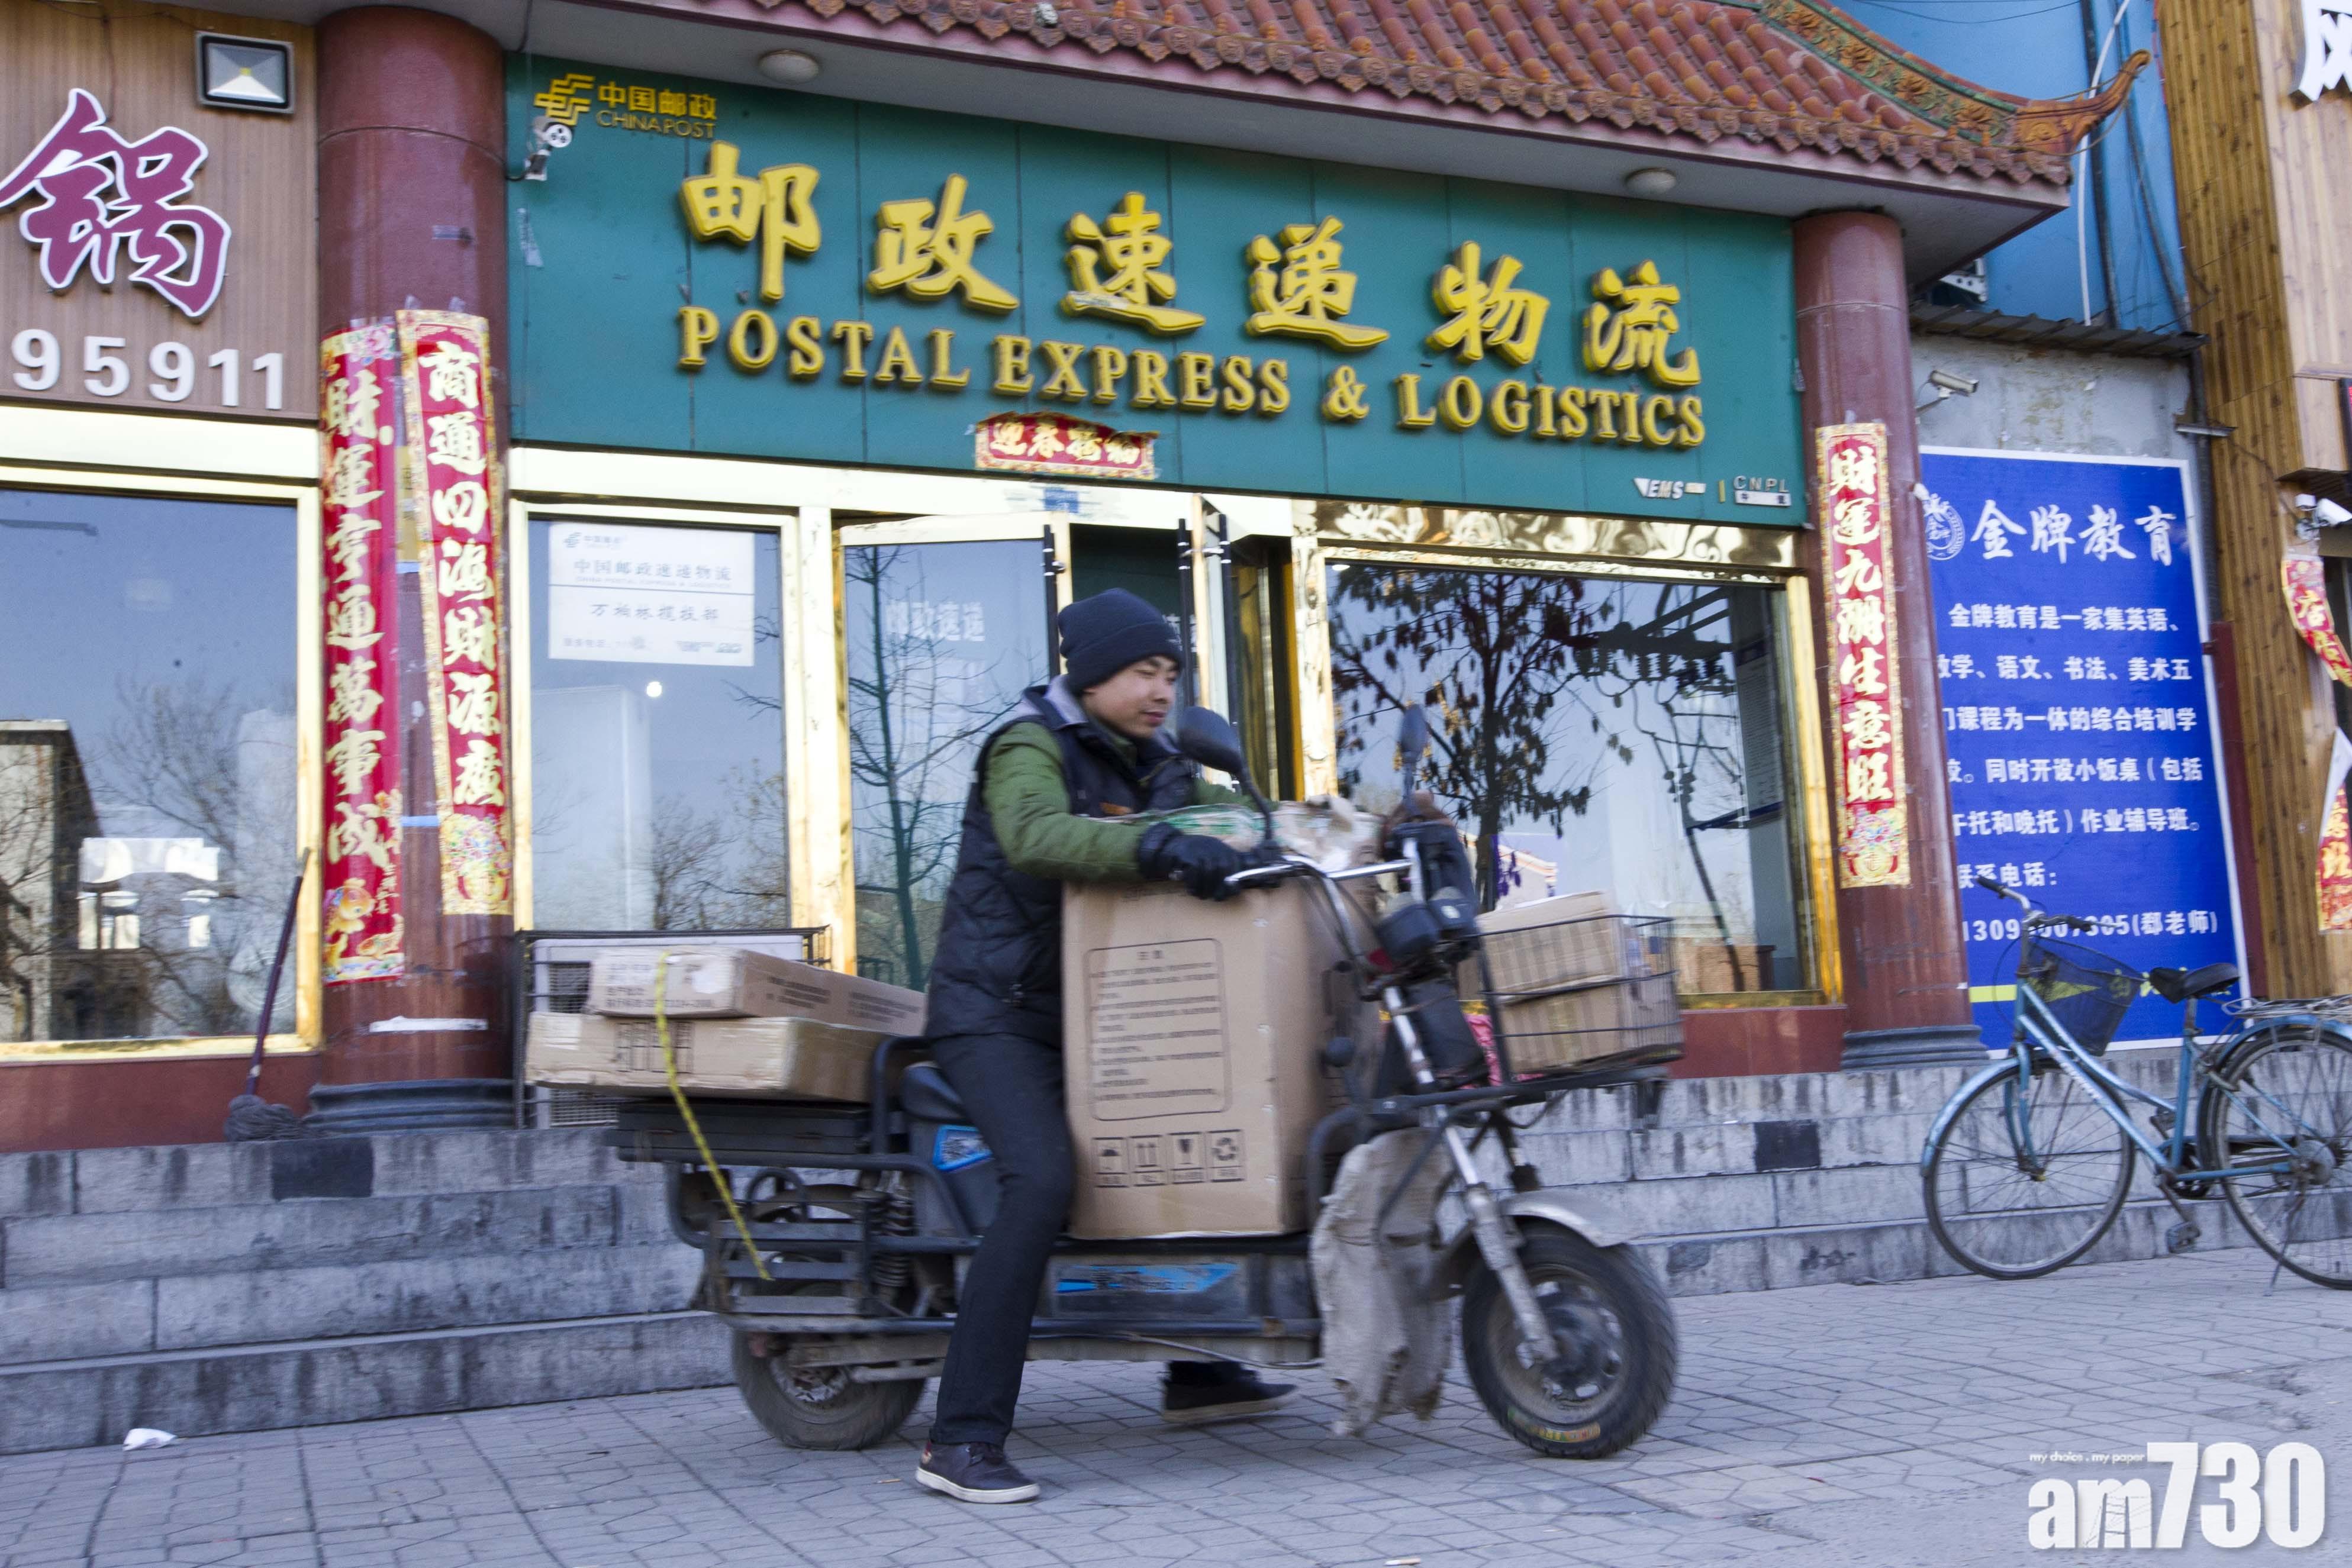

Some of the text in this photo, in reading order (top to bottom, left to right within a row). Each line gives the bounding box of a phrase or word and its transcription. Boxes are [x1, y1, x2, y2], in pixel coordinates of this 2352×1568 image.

[596, 109, 716, 138] CHINA POST
[598, 81, 717, 120] 中国邮政
[681, 140, 1701, 389] 邮政速递物流
[11, 328, 283, 410] 95911
[677, 305, 1706, 450] POSTAL EXPRESS & LOGISTICS
[1647, 479, 1684, 499] EMS
[1733, 475, 1790, 493] CNPL
[1970, 499, 2177, 566] 金牌教育
